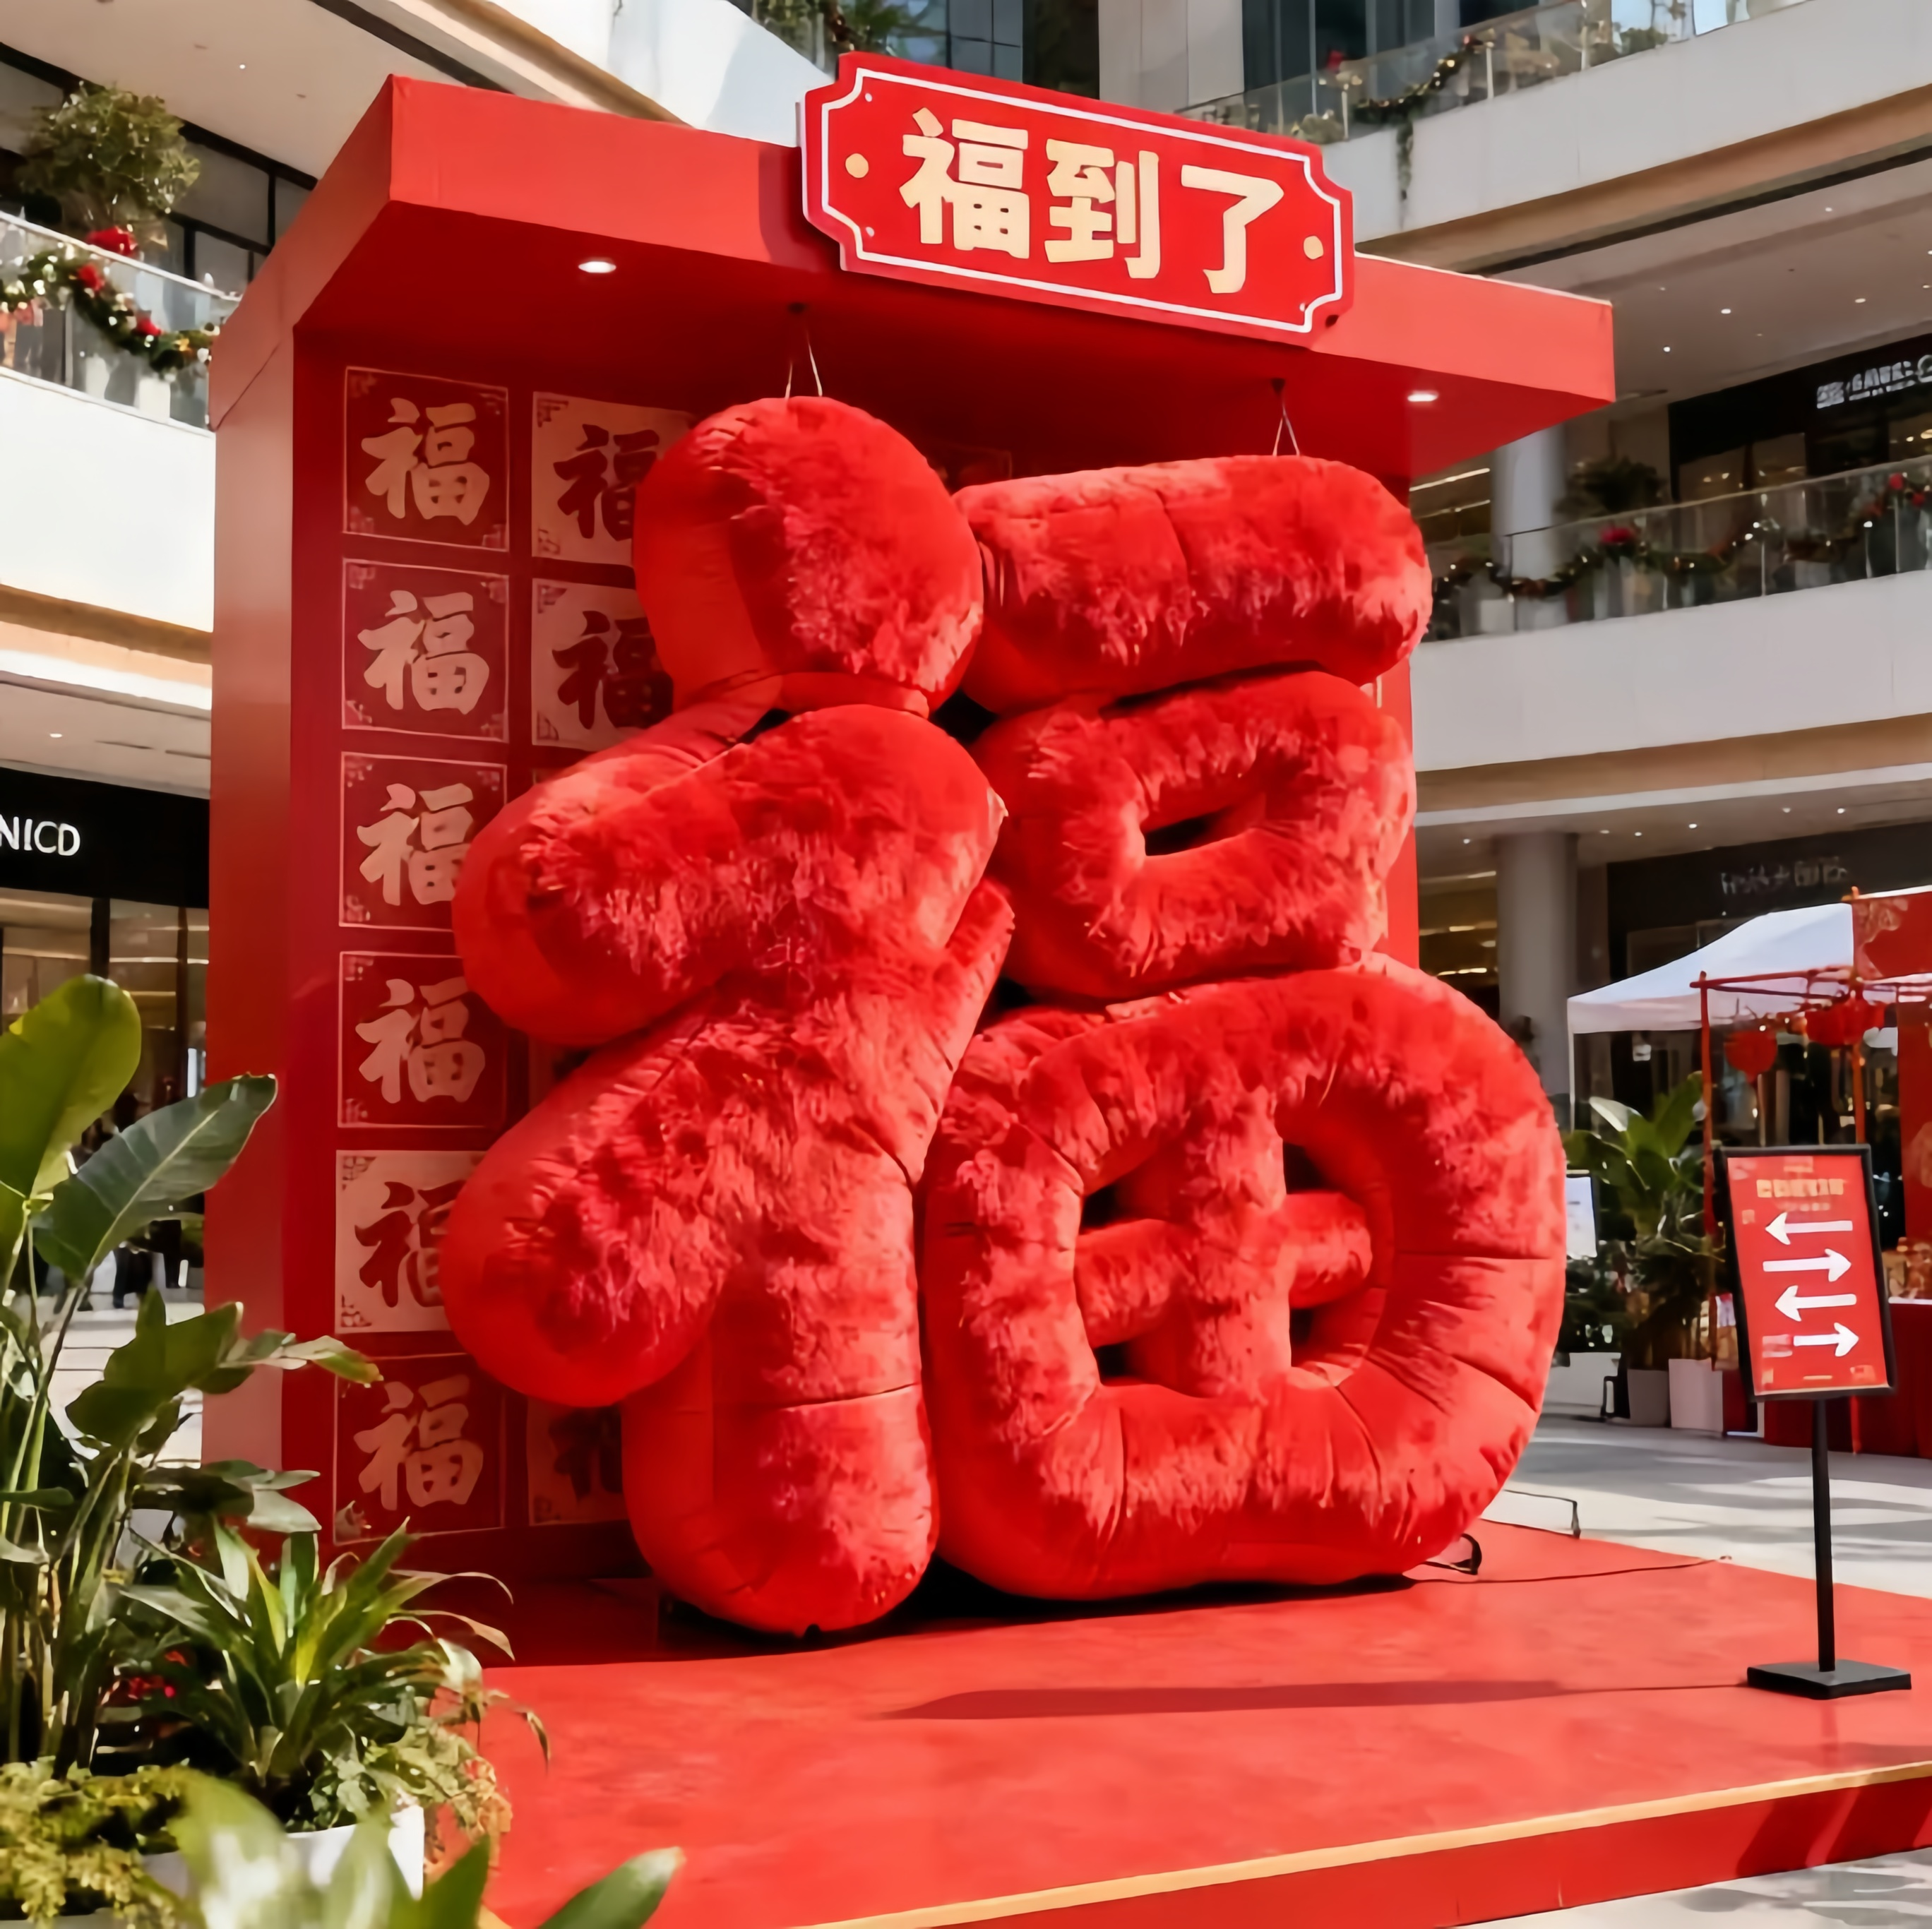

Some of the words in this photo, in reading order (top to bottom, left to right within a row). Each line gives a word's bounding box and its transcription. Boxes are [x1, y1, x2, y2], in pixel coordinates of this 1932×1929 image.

[900, 107, 1284, 294] 福到了
[362, 398, 489, 525] 福
[553, 424, 660, 542] 福
[358, 590, 489, 715] 福
[552, 610, 674, 730] 福
[357, 783, 474, 906] 福
[355, 977, 486, 1104] 福
[353, 1374, 484, 1511] 福
